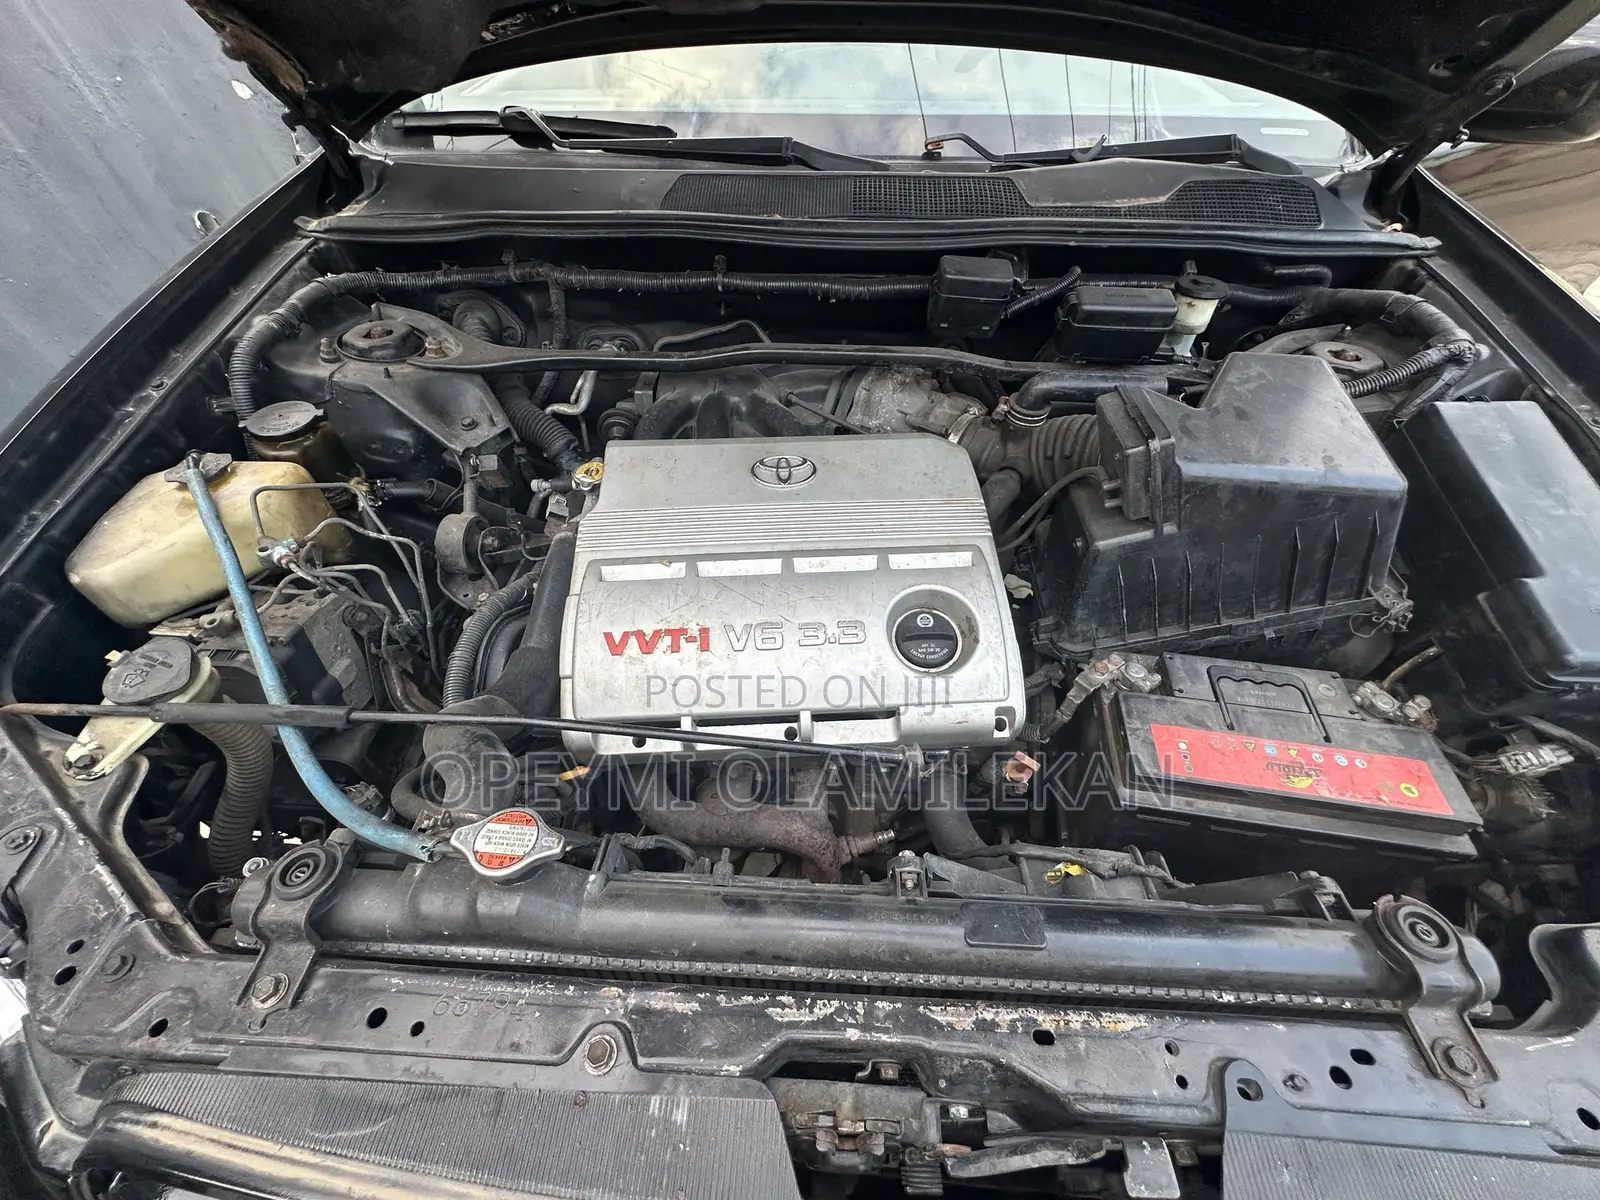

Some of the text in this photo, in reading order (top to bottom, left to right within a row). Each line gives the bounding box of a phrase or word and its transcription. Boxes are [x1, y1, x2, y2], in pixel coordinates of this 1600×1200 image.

[603, 619, 867, 656] VVT-i V6 3.3
